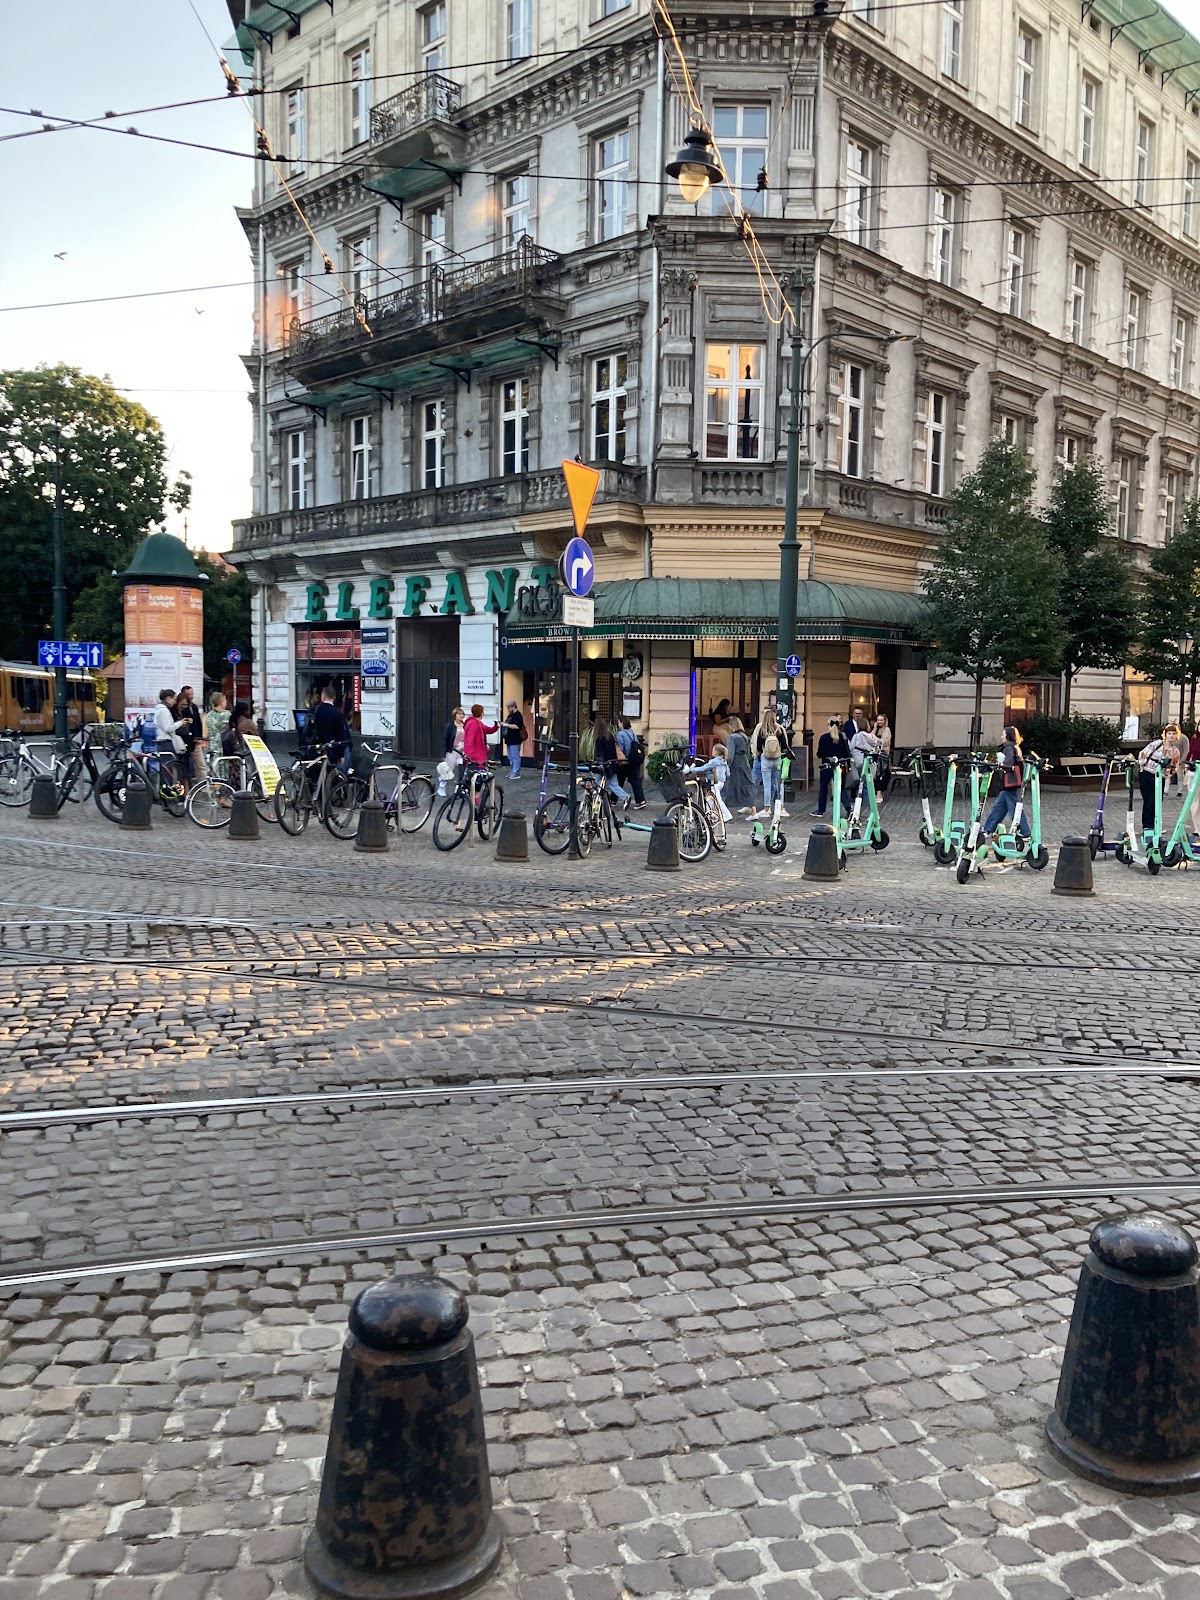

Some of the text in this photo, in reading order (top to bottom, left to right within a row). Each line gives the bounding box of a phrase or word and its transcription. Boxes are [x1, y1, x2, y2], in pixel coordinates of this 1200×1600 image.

[305, 566, 556, 621] ELEFANT
[548, 627, 580, 637] BROWR
[701, 626, 767, 635] RESTAURACJA
[889, 630, 903, 640] PUB
[337, 637, 352, 645] BAZAR
[363, 660, 387, 671] BIELIZNA
[365, 676, 387, 687] NEW GIRL
